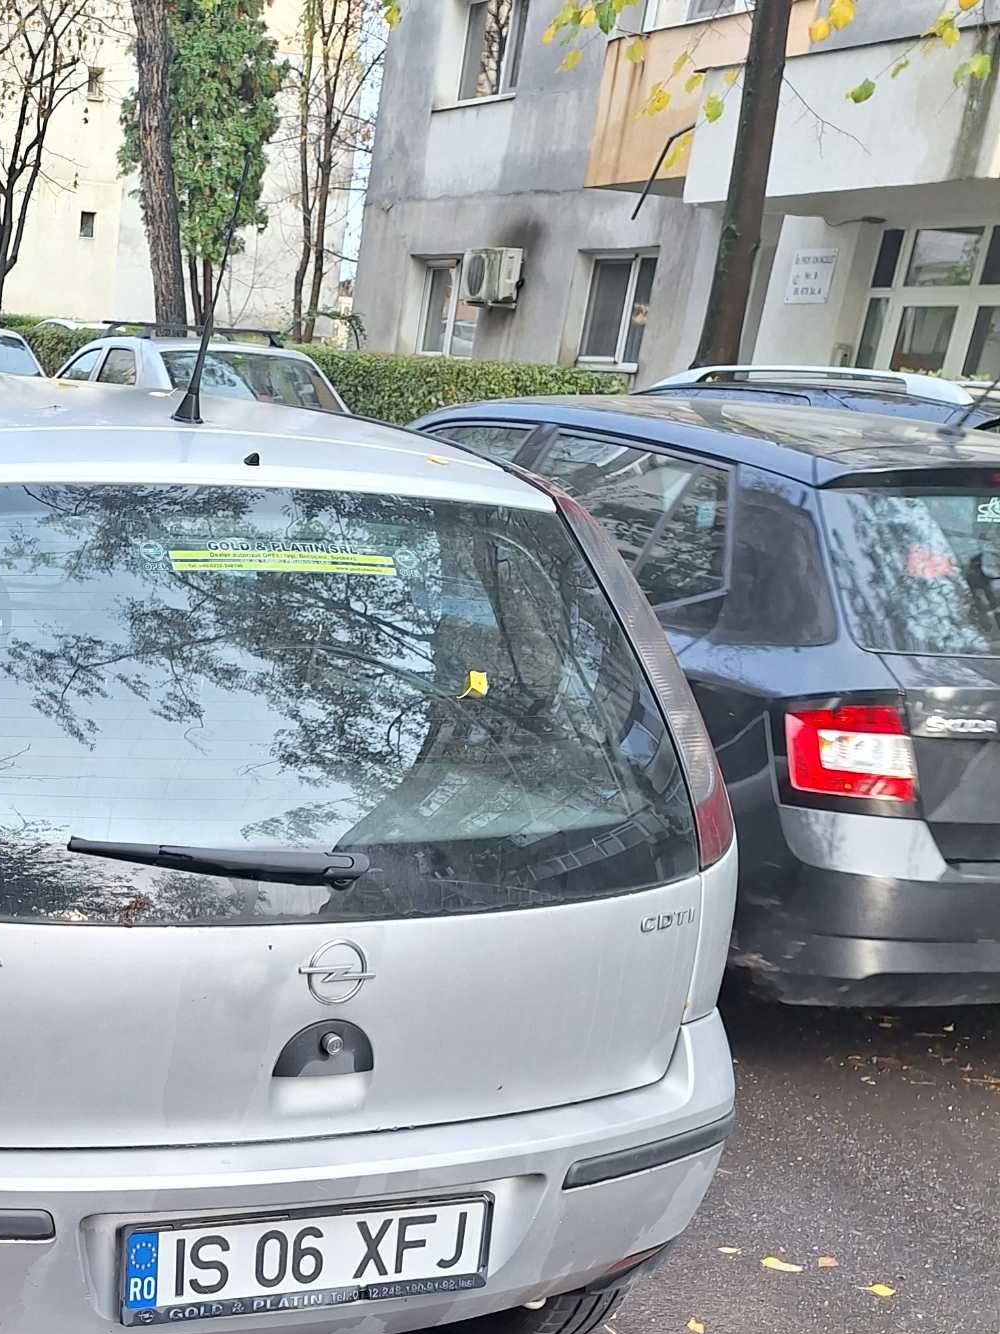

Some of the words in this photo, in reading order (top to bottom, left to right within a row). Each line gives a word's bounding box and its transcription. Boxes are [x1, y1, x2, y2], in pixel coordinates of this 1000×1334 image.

[207, 541, 249, 551] GOLD
[256, 542, 269, 551] &
[271, 542, 326, 553] PLATIN
[174, 1235, 230, 1298] IS
[255, 1226, 324, 1288] 06
[352, 1212, 468, 1279] XFJ
[129, 1276, 155, 1302] RO
[168, 1304, 223, 1320] GOLD
[231, 1303, 245, 1314] &
[252, 1294, 323, 1311] PLATIN
